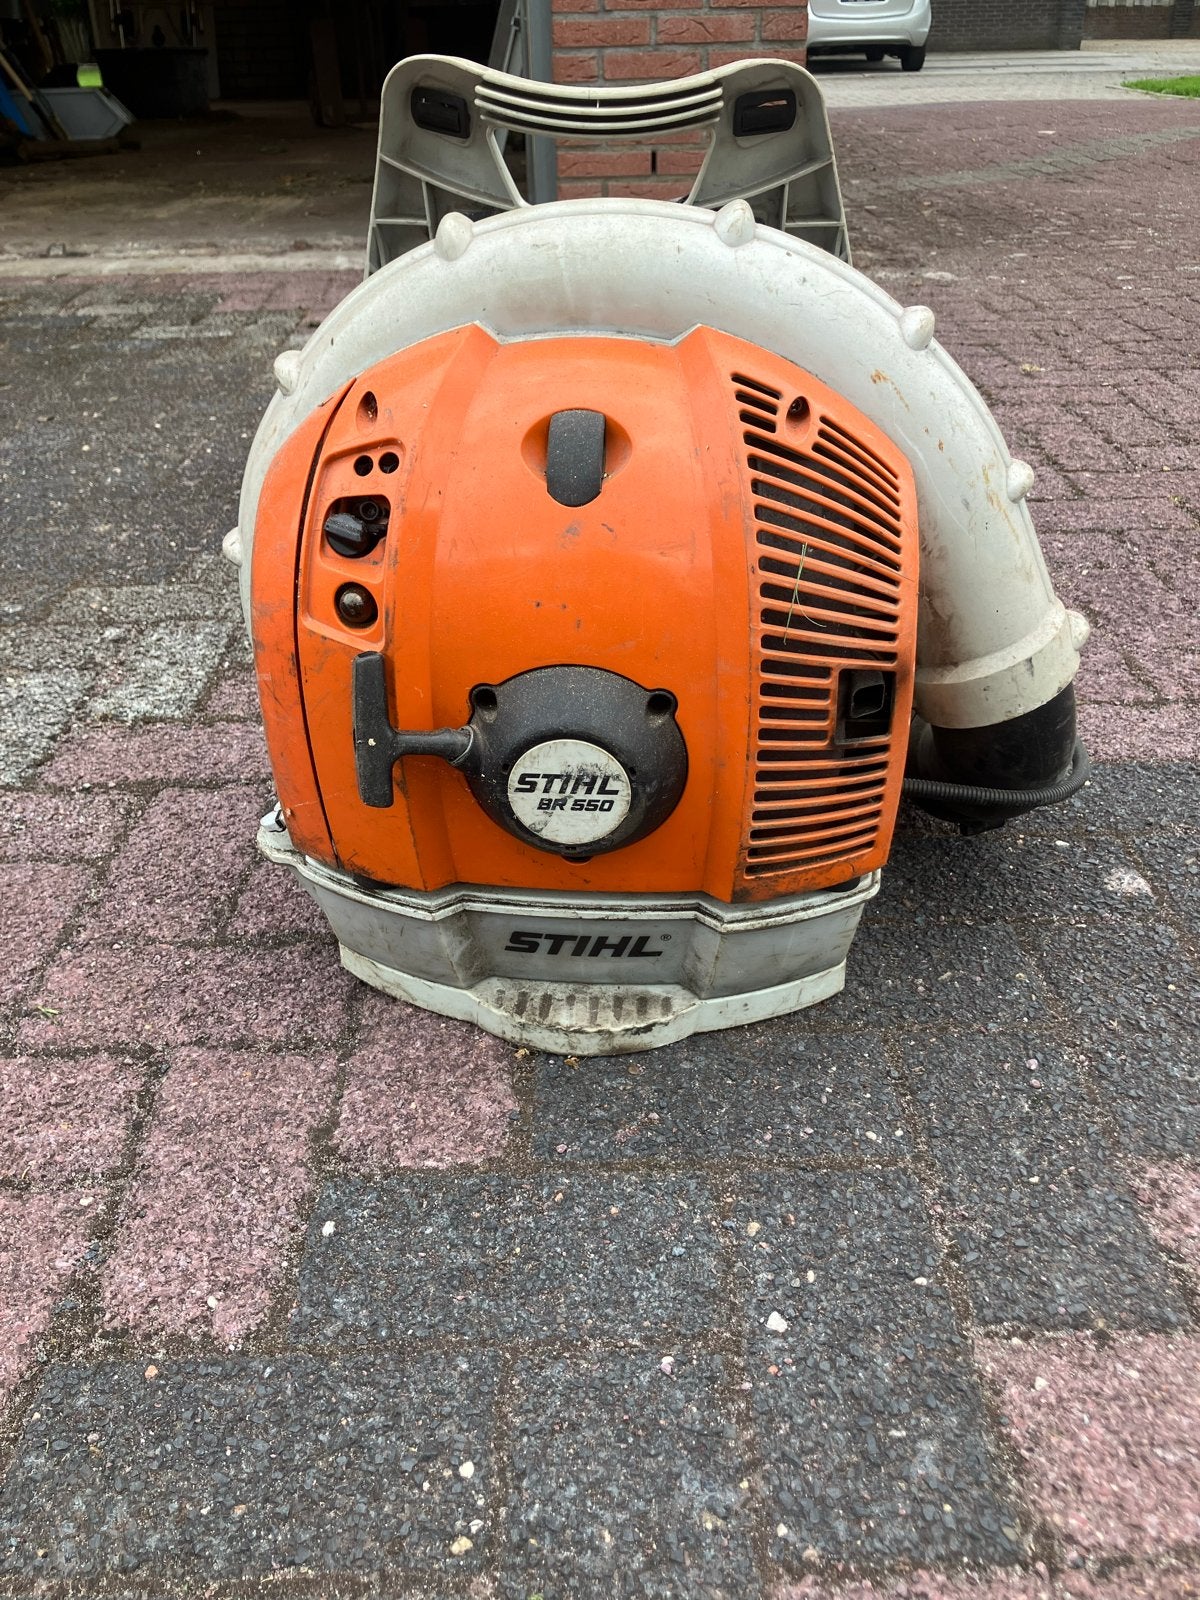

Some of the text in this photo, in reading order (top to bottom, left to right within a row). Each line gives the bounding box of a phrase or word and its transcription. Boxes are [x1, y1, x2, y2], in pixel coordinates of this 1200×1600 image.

[514, 773, 620, 796] STIHL
[537, 798, 615, 812] BR 550
